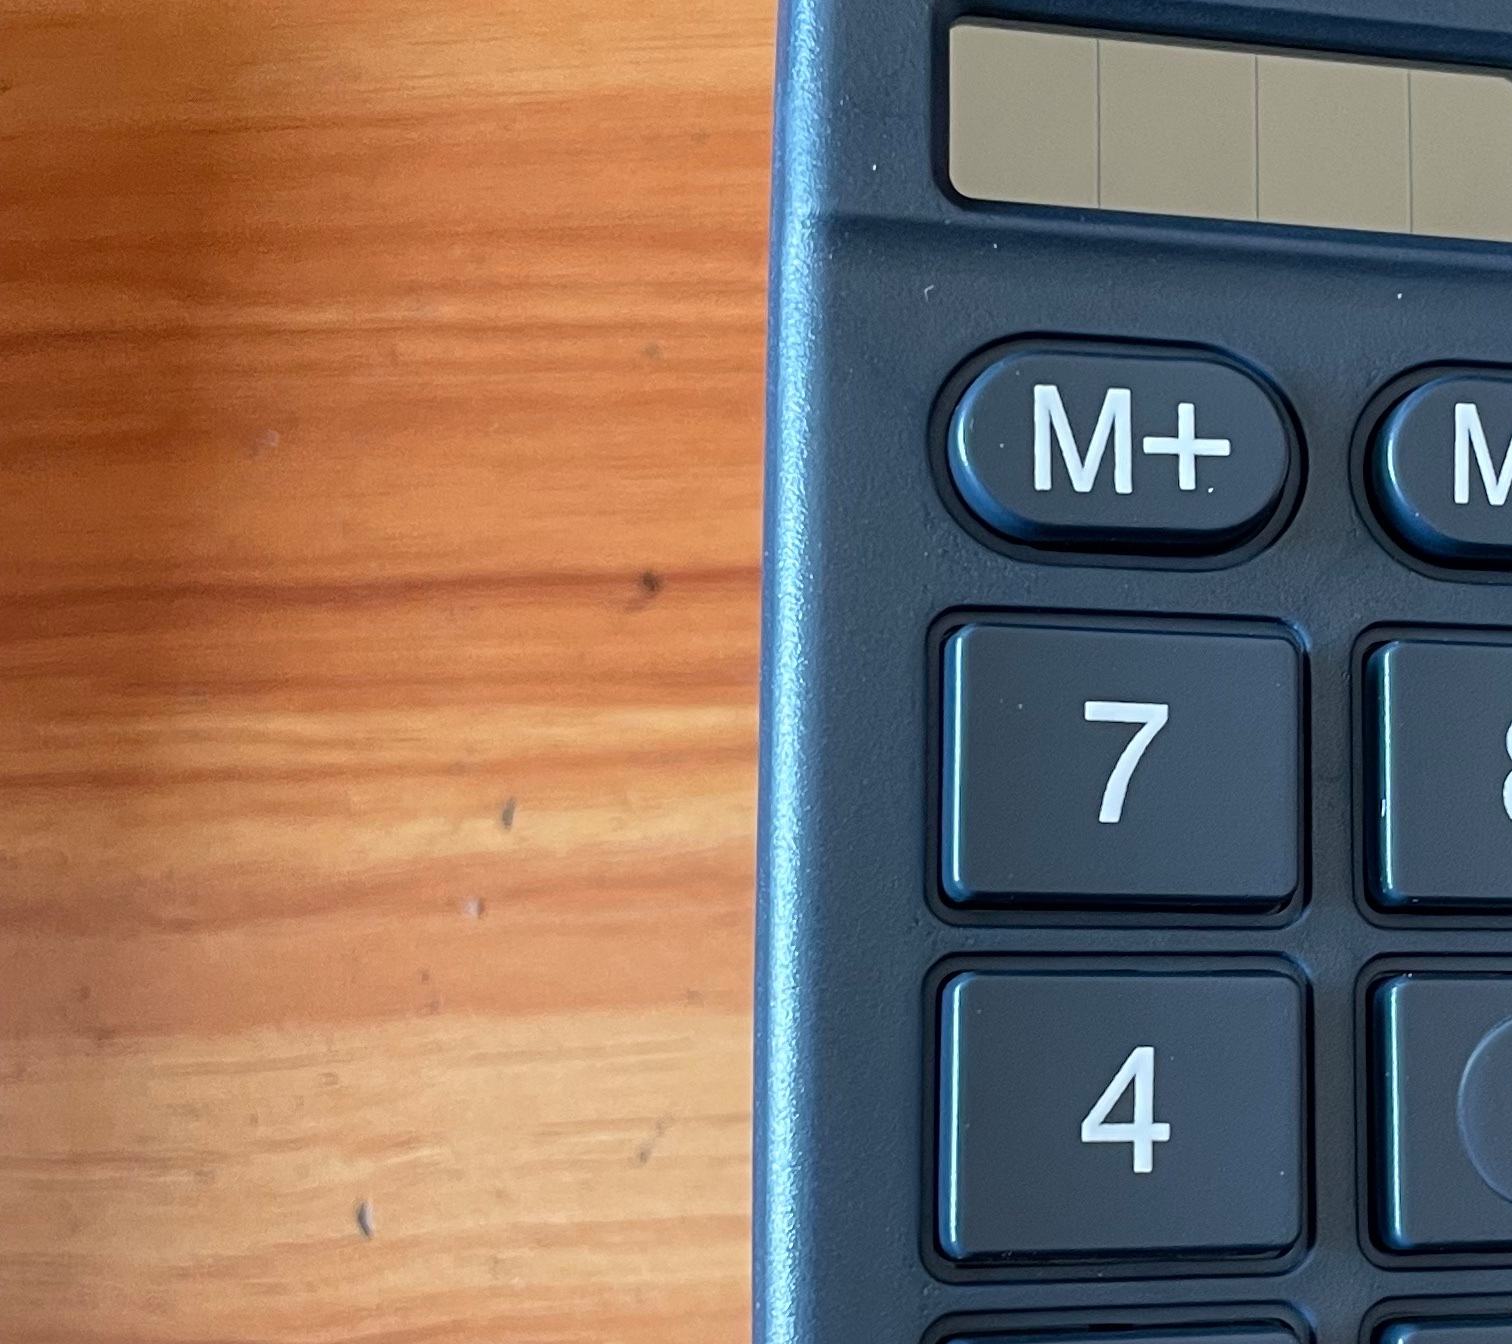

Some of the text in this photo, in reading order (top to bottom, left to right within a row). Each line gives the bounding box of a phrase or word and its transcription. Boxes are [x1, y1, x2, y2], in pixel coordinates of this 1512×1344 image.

[1032, 383, 1231, 493] M+
[1083, 700, 1170, 824] 7
[1080, 1045, 1171, 1174] 4
